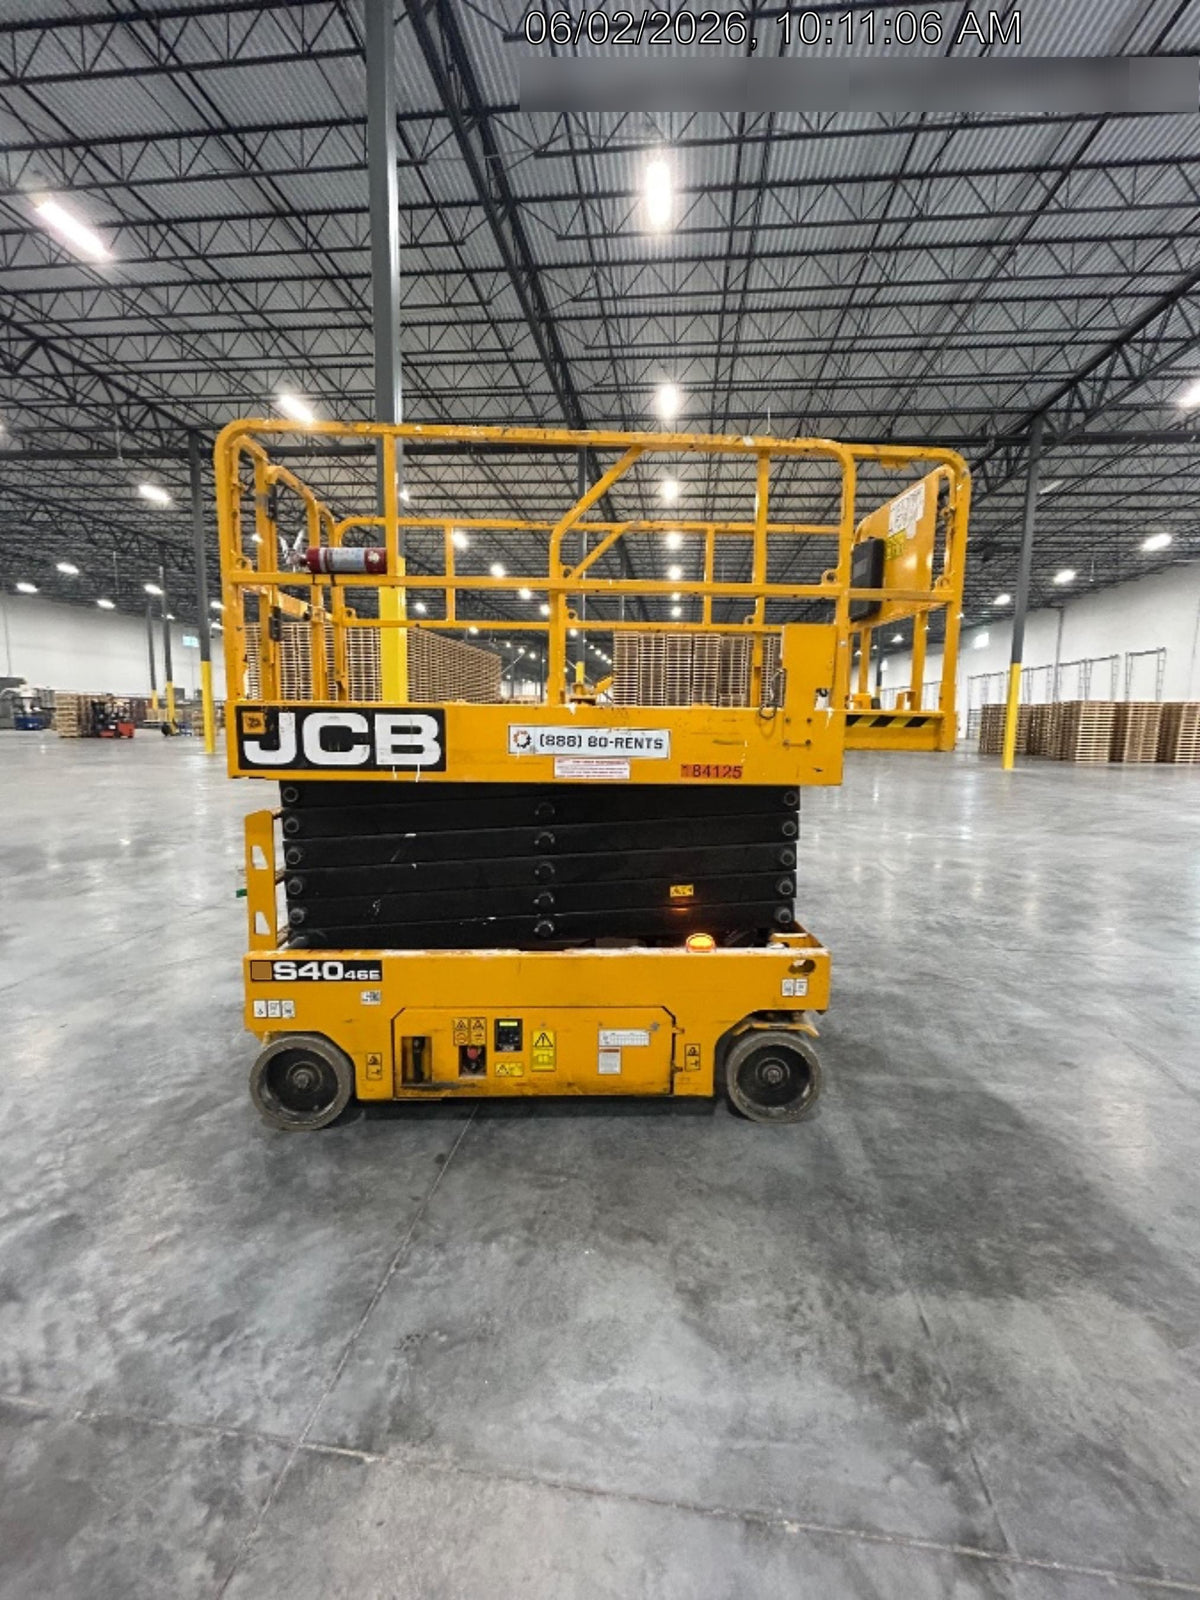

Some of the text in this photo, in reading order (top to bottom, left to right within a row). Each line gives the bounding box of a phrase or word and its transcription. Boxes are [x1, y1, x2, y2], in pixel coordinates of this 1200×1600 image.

[243, 711, 442, 766] JCB
[539, 733, 664, 750] (888) 80-RENTS
